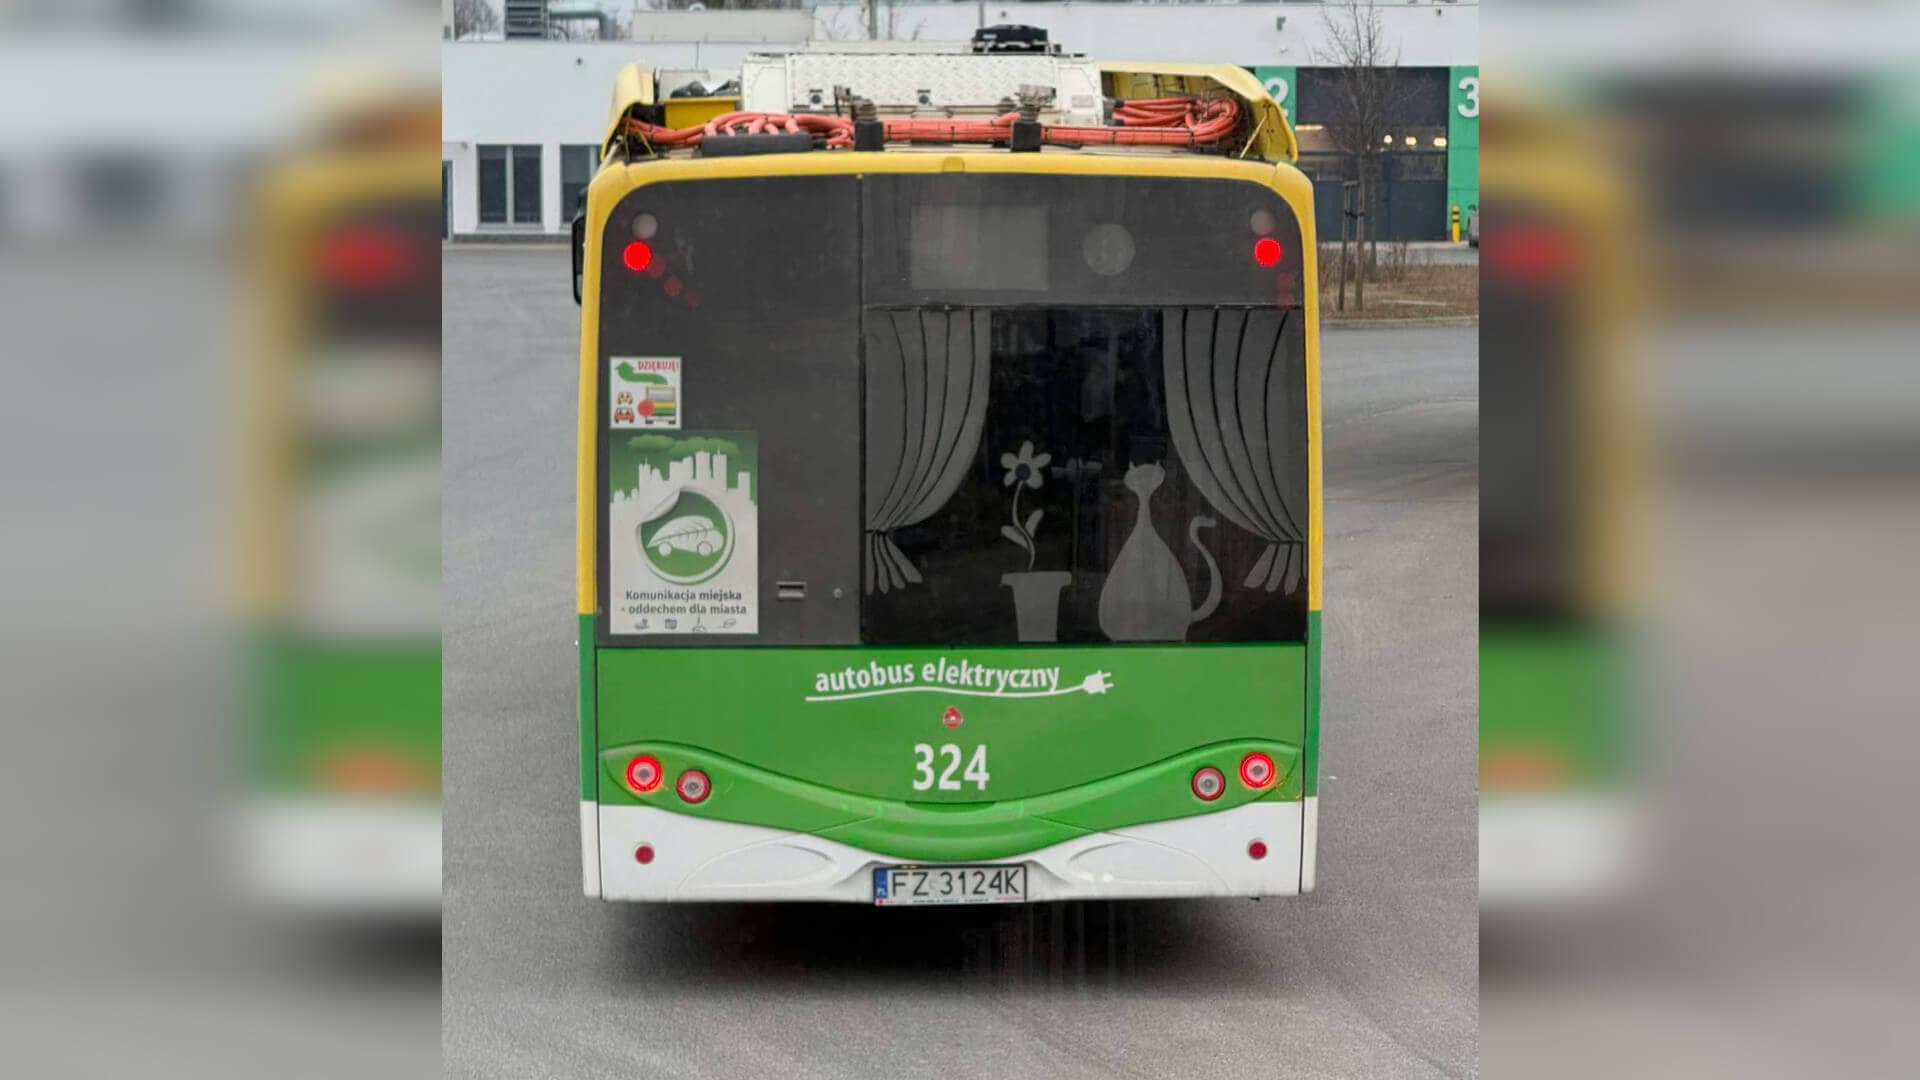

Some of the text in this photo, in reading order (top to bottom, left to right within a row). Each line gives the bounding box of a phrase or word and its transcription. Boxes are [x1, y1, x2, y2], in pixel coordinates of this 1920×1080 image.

[1457, 76, 1479, 118] 3
[626, 589, 742, 601] Komunikacja miejska
[628, 603, 687, 614] oddechem
[690, 603, 707, 614] dla
[710, 603, 747, 614] miasta
[815, 657, 1061, 696] autobus elektryczny
[912, 743, 990, 791] 324
[891, 869, 1020, 897] FZ 3124K
